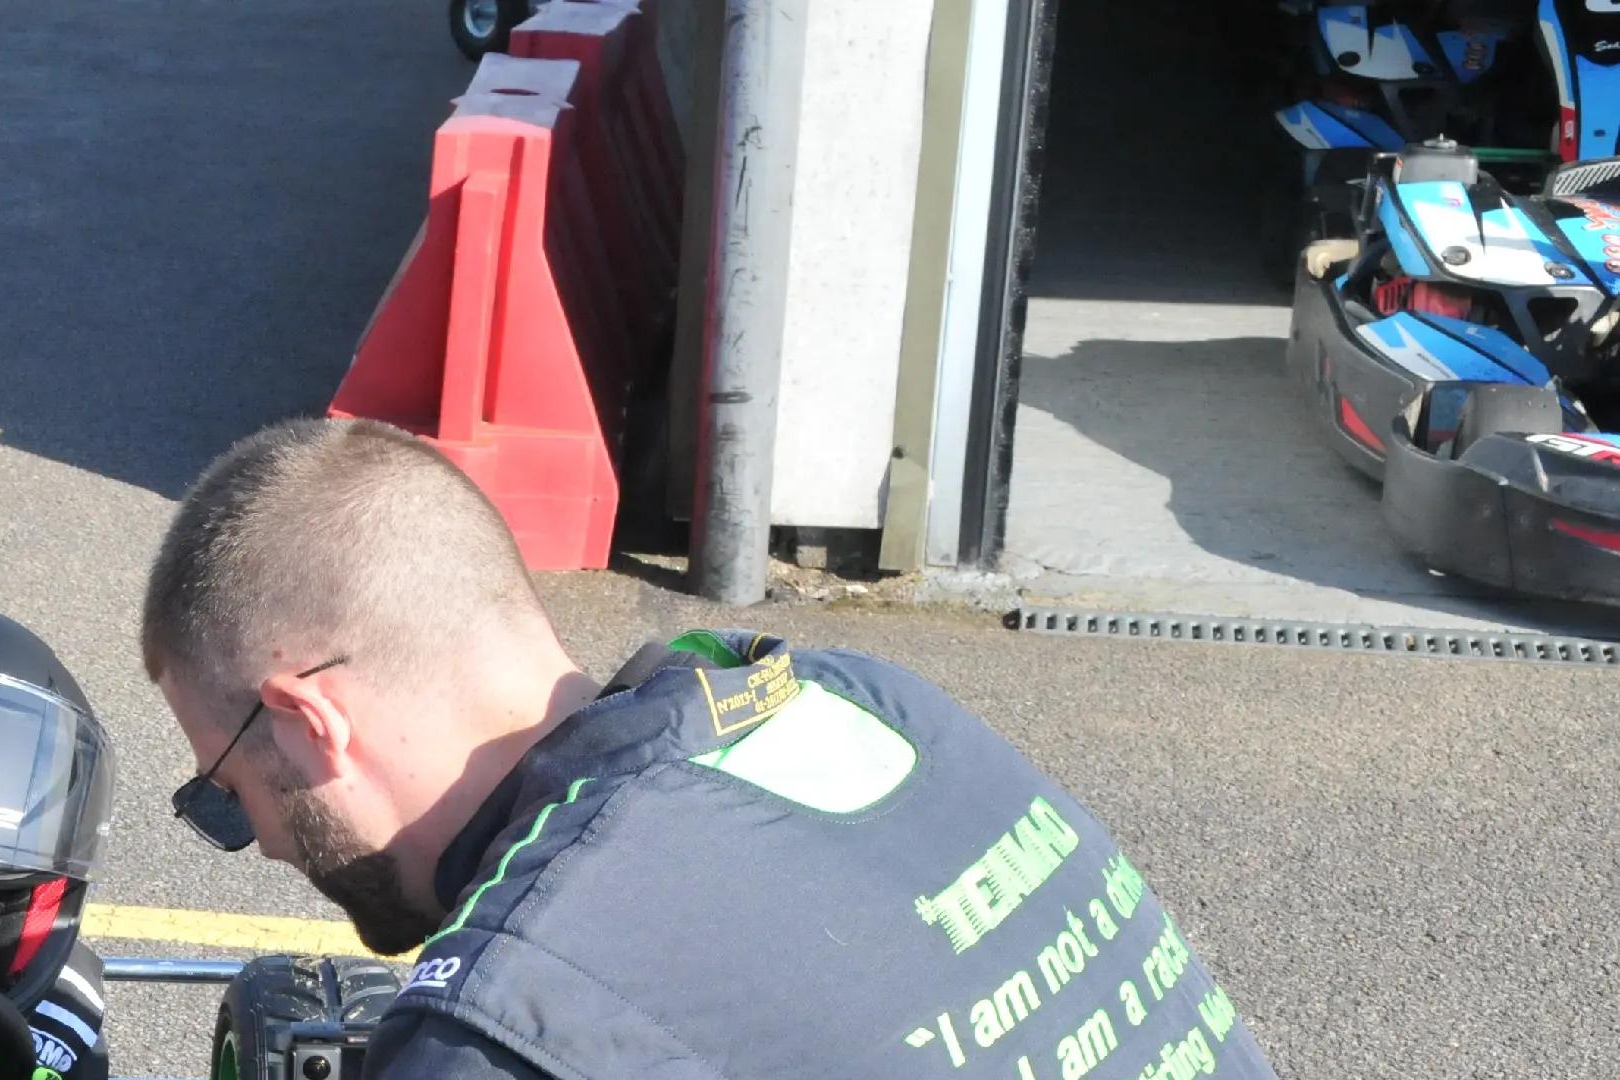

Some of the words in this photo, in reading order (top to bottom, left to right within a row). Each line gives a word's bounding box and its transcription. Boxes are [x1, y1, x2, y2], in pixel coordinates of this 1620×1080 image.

[970, 970, 1042, 1047] am
[1036, 905, 1099, 994] not
[1089, 898, 1119, 940] a
[1119, 980, 1148, 1026] a
